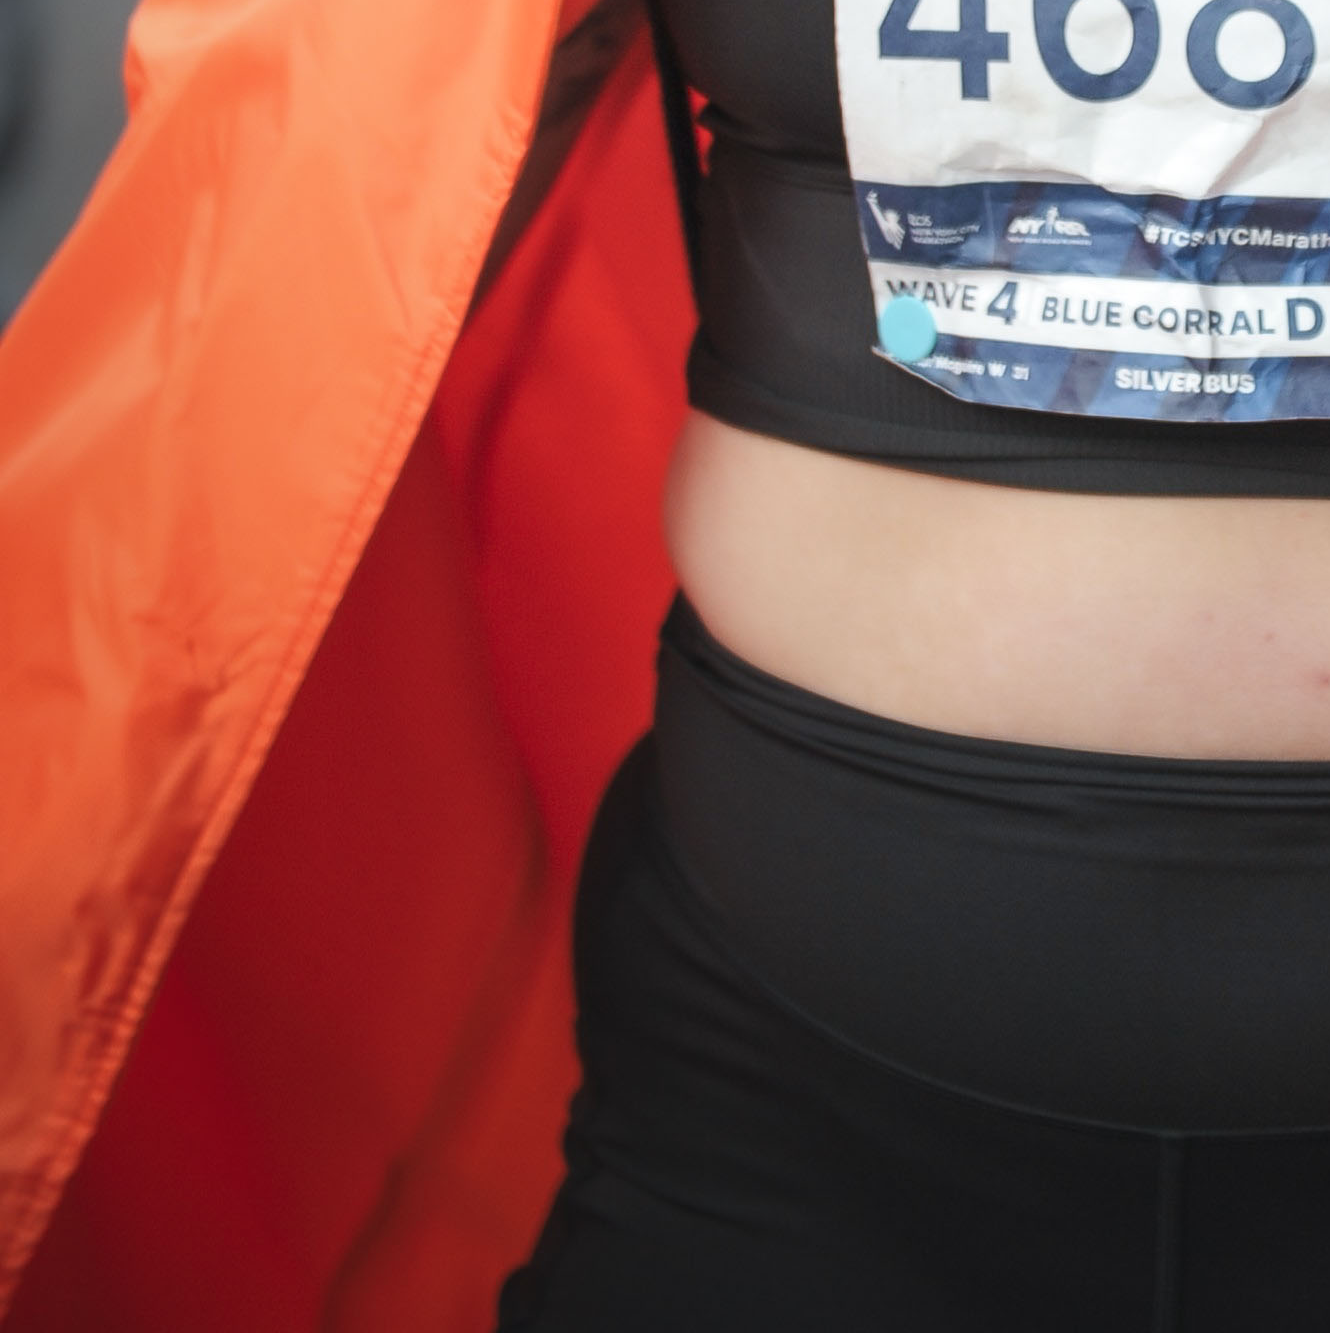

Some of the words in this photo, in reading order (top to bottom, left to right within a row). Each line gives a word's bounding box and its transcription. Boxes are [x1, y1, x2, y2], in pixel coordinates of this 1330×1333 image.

[986, 281, 1019, 326] 4
[1042, 296, 1122, 328] BLUE
[1133, 304, 1276, 336] CORRAL
[1286, 296, 1325, 341] D
[1115, 368, 1200, 393] SILVER
[1203, 373, 1256, 395] BUS
